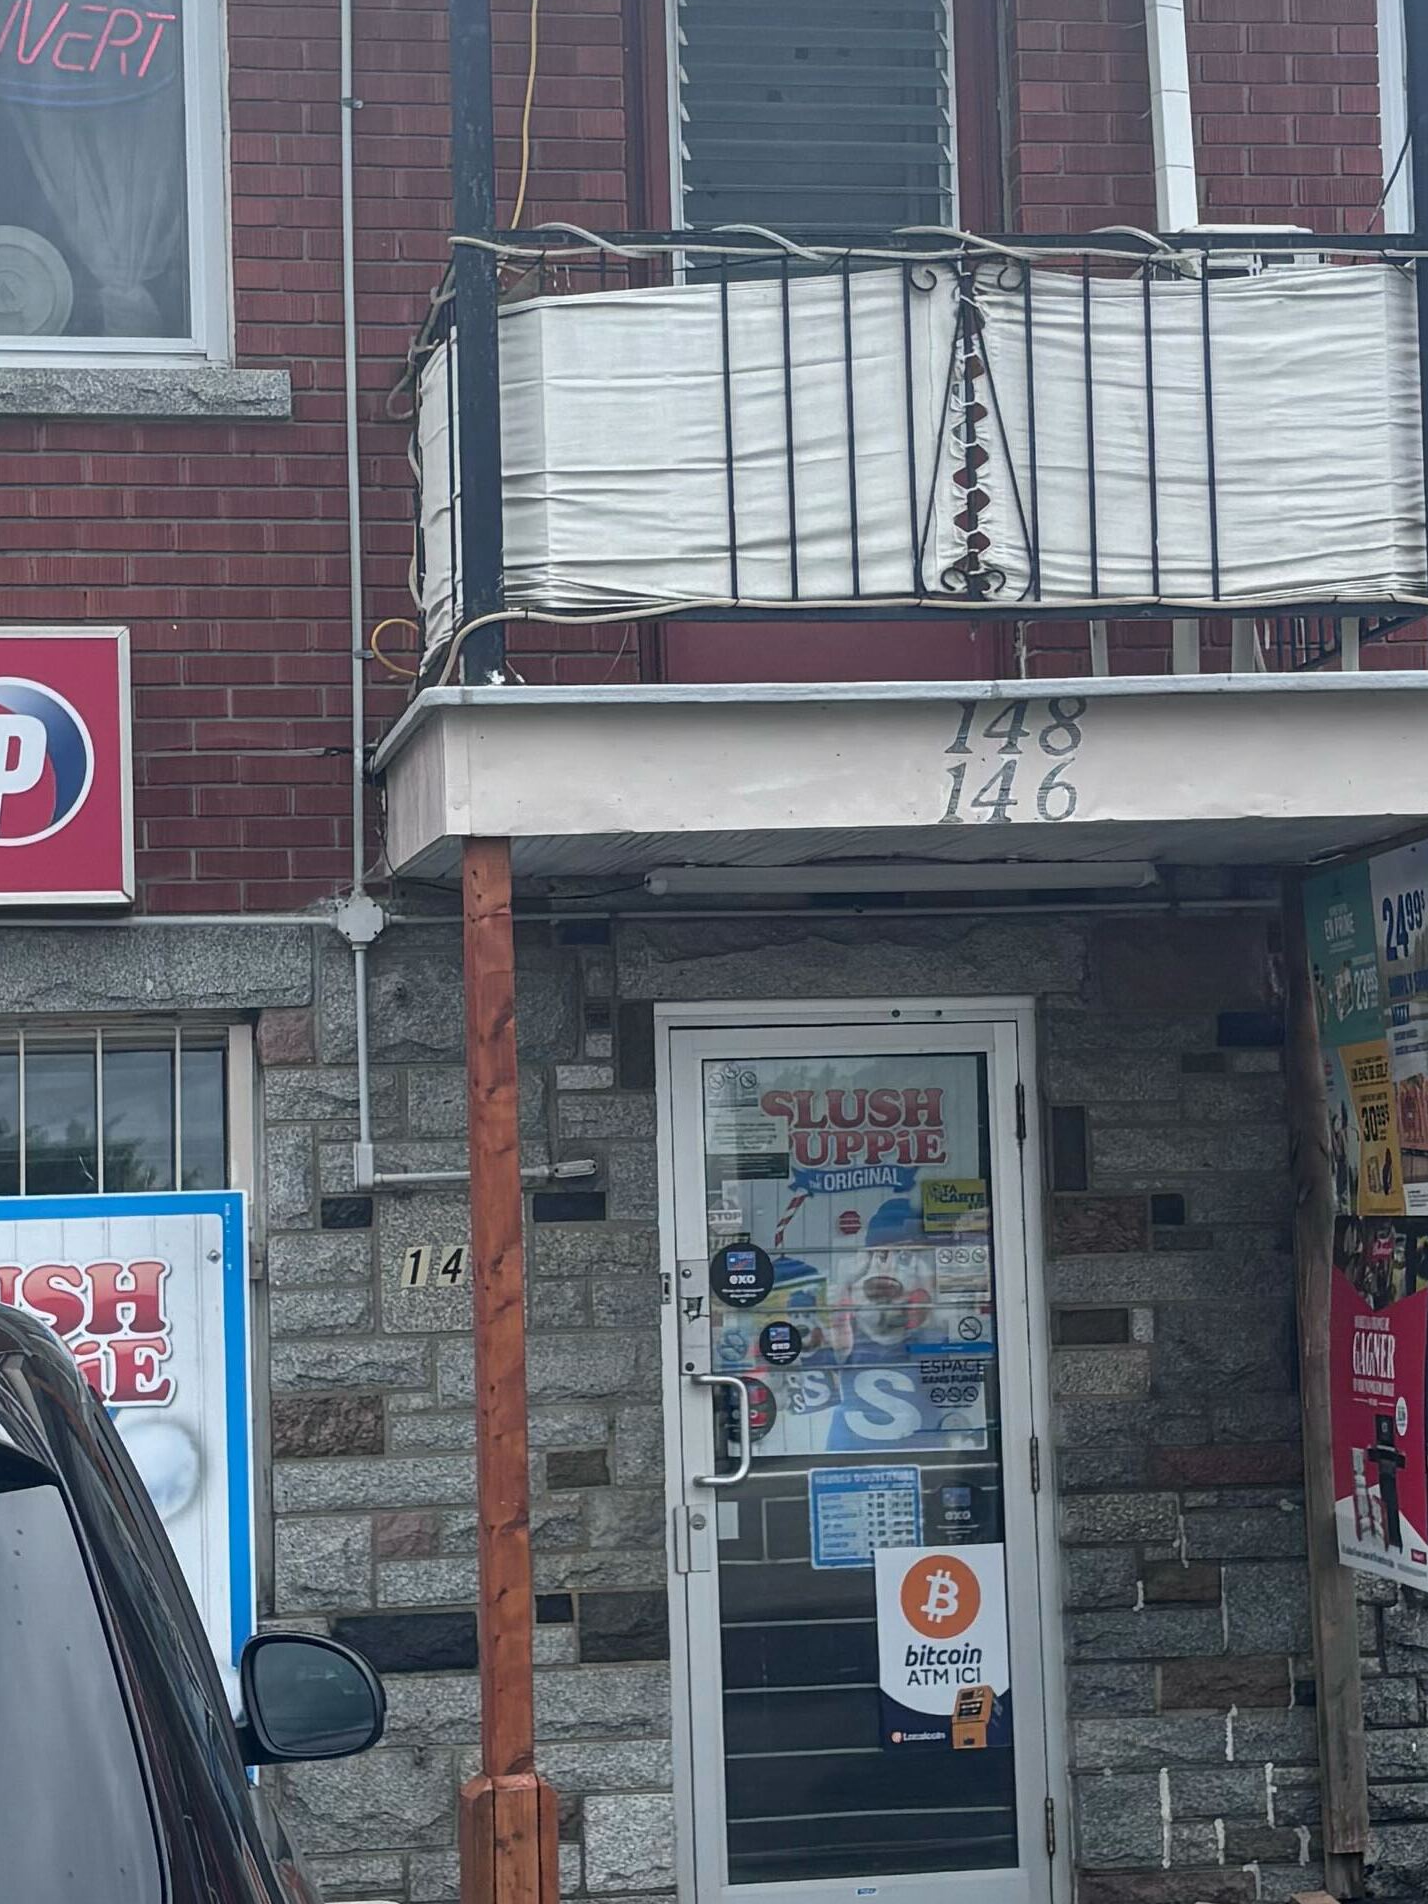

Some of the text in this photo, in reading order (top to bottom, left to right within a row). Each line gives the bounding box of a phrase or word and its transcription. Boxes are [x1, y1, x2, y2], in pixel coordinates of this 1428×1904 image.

[945, 700, 1087, 756] 148
[938, 758, 1077, 823] 146
[760, 1088, 945, 1129] SLUSH
[824, 1167, 899, 1191] ORIGINAL
[729, 1275, 756, 1284] exo
[1353, 1331, 1396, 1379] GAGNER
[905, 1642, 982, 1666] bitcoin
[907, 1667, 981, 1685] ATM ICI
